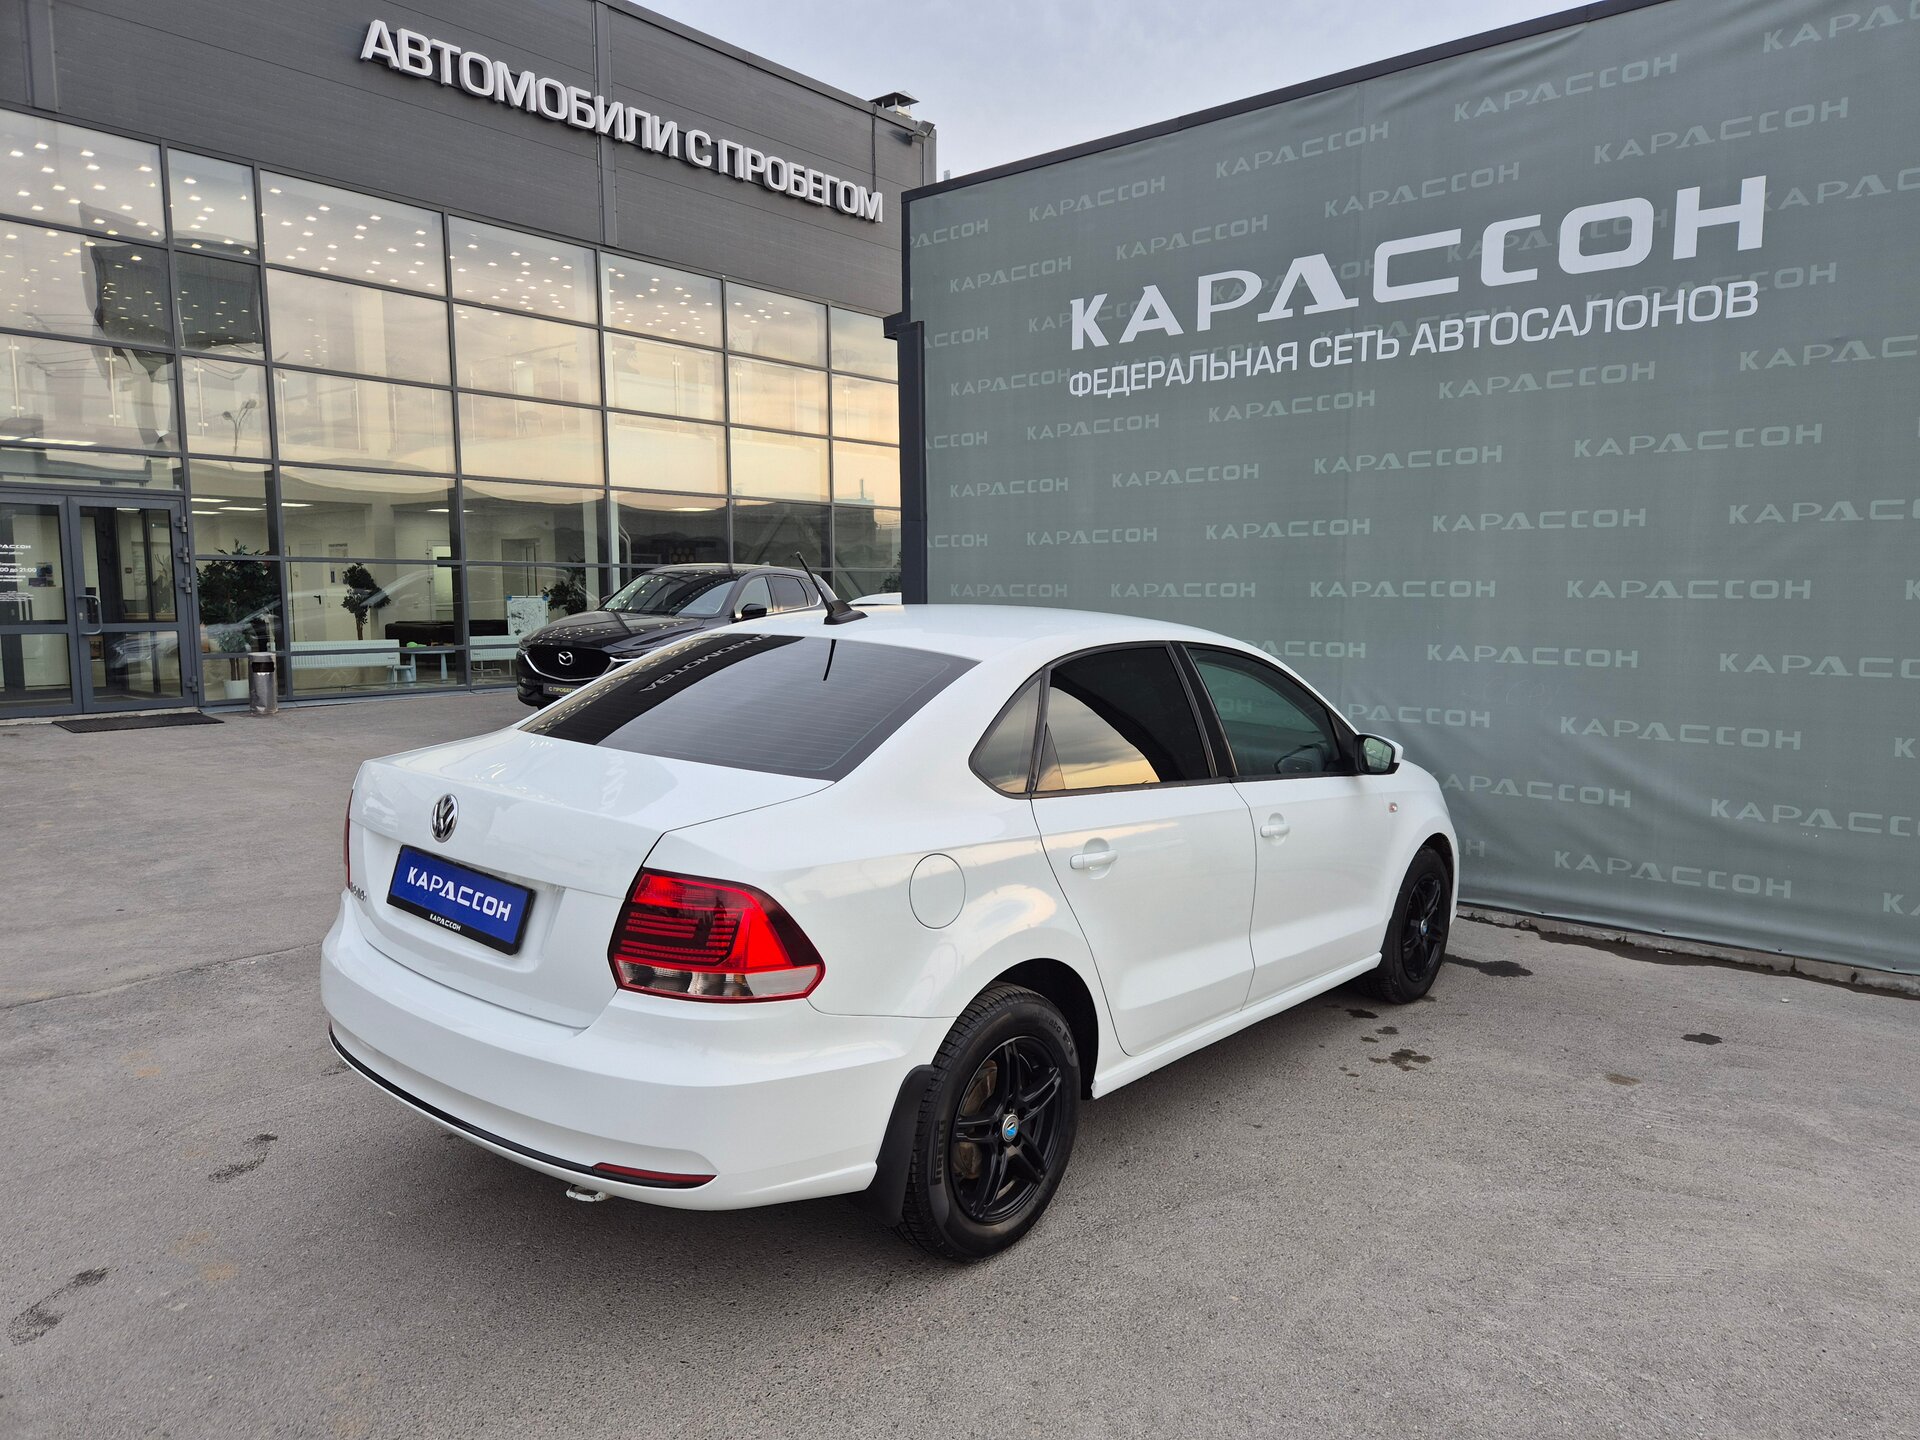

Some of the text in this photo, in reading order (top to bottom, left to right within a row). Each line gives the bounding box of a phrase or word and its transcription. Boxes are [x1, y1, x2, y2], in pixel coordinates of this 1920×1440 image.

[361, 19, 884, 223] АВТОМОБИЛИ С ПРОБЕГОМ
[1069, 280, 1759, 398] ФЕДЕРАЛЬНАЯ СЕТЬ АВТОСАЛОНОВ
